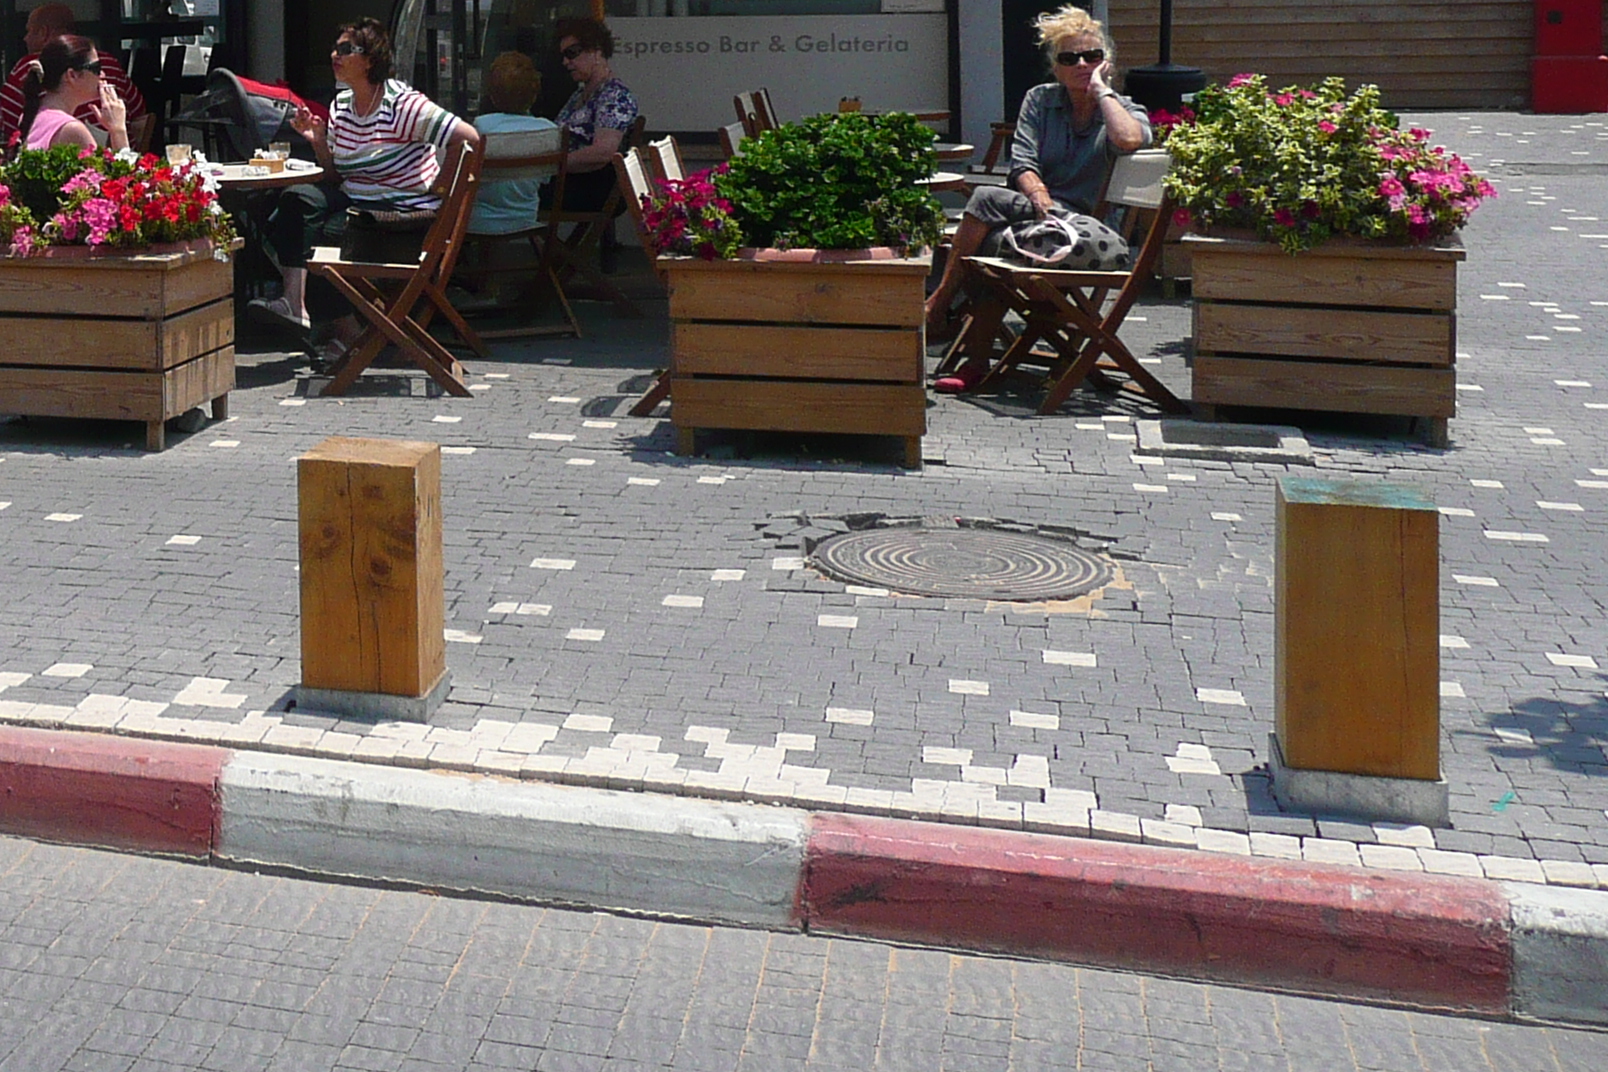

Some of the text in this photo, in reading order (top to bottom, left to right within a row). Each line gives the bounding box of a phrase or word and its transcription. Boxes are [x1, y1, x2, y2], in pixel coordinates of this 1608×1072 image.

[612, 33, 910, 58] Espresso Bar & Gelateria
